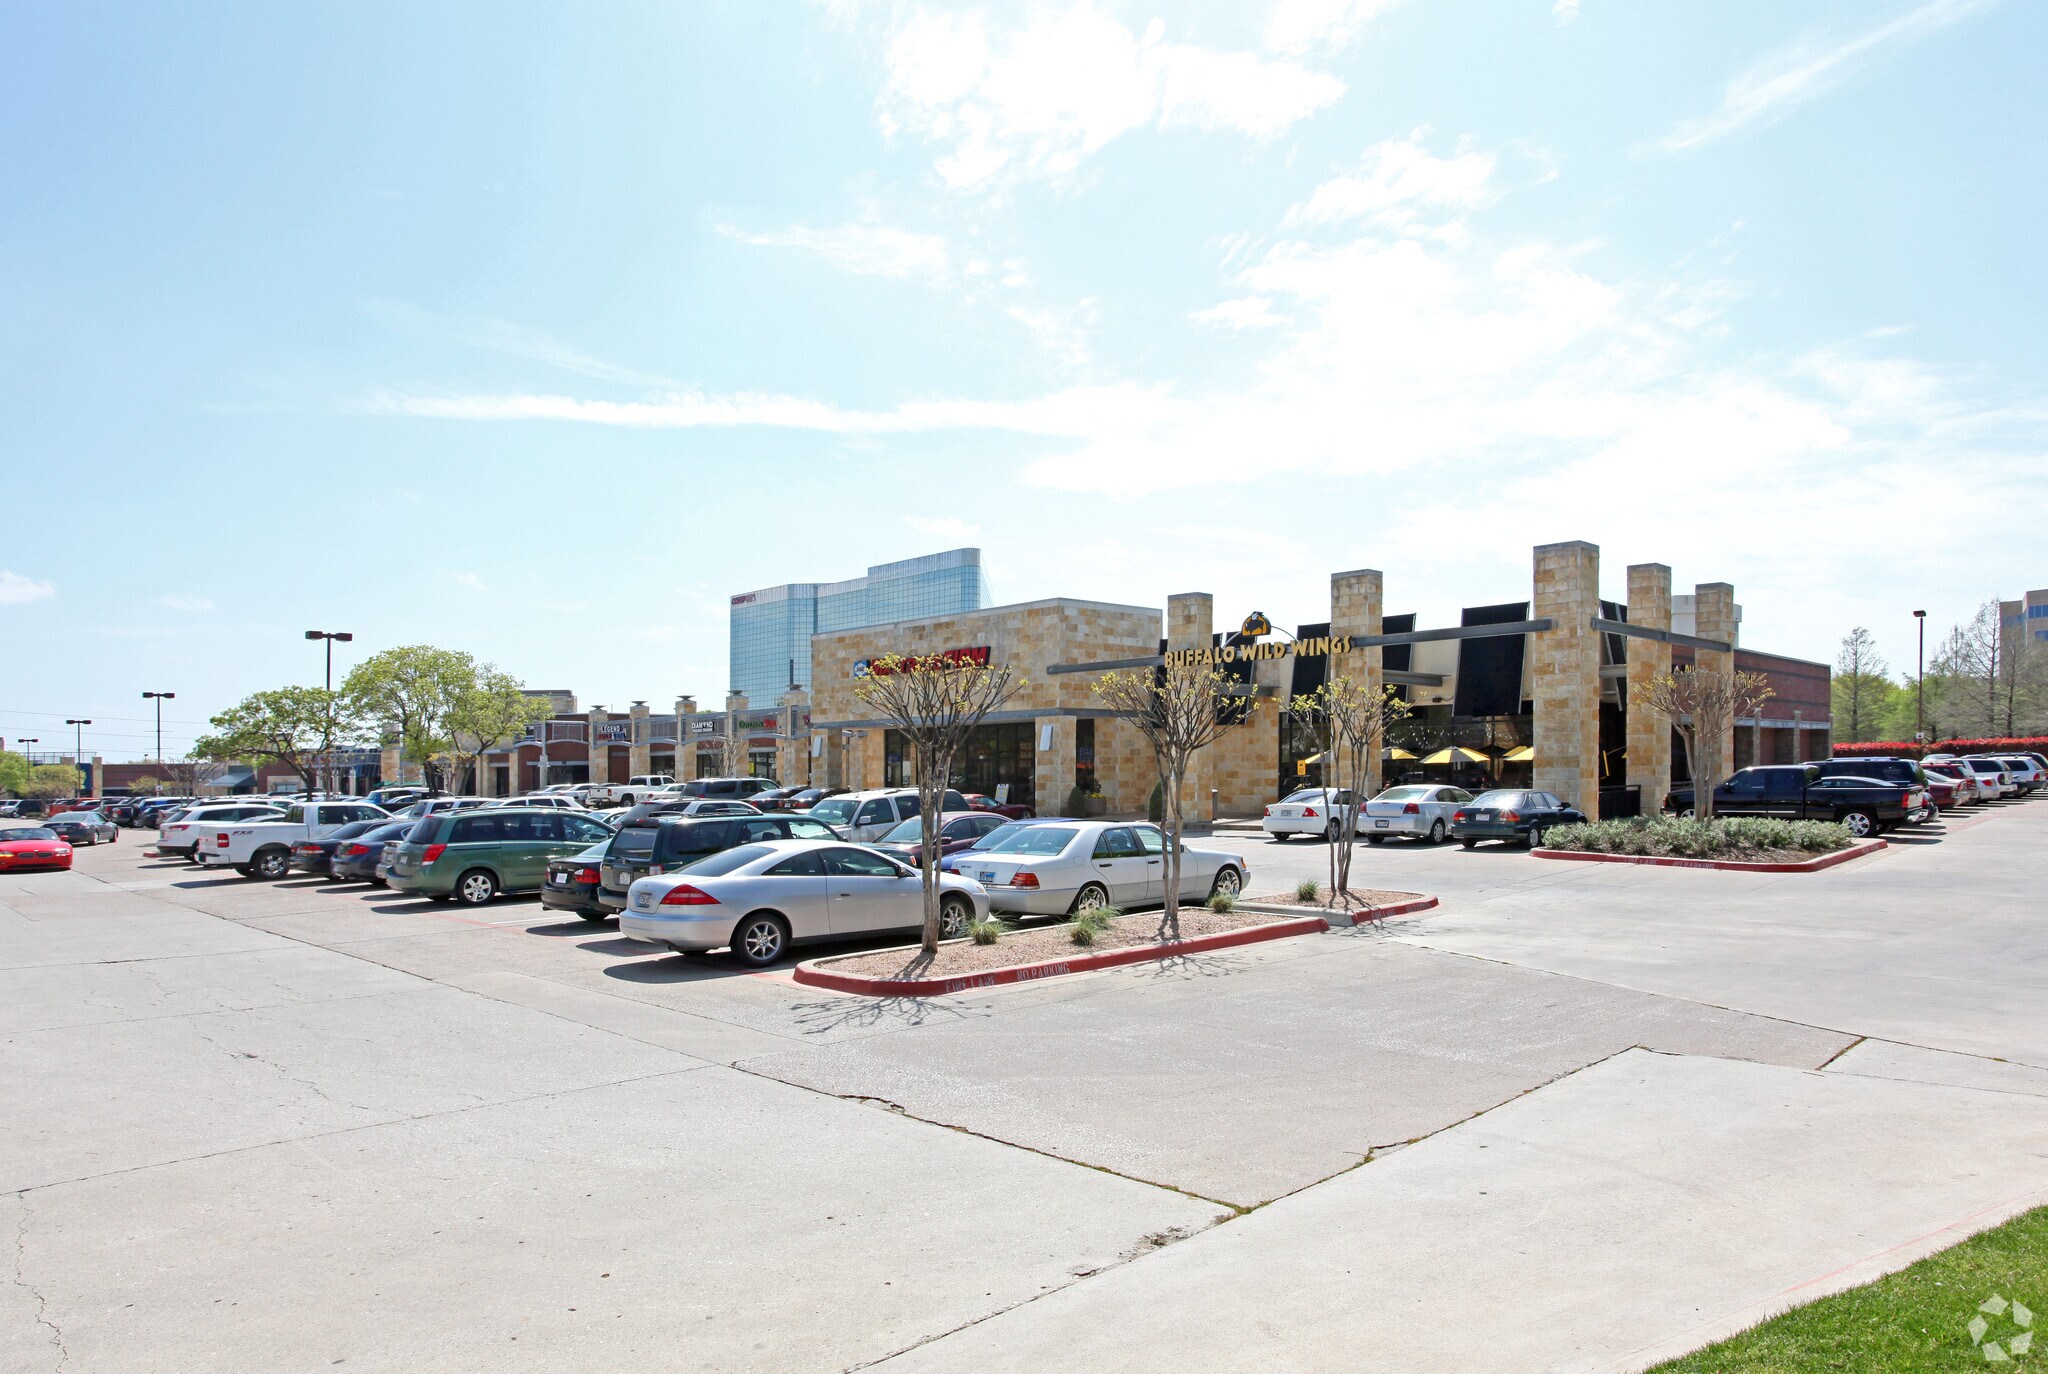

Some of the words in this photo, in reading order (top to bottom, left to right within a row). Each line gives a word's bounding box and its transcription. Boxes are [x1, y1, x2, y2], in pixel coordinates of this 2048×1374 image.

[1164, 647, 1237, 668] BUFFALO
[1240, 641, 1287, 662] WILD
[1291, 635, 1352, 657] WINGS
[601, 725, 620, 733] LEGEND
[1016, 969, 1029, 981] NO
[1031, 962, 1070, 979] PARKING
